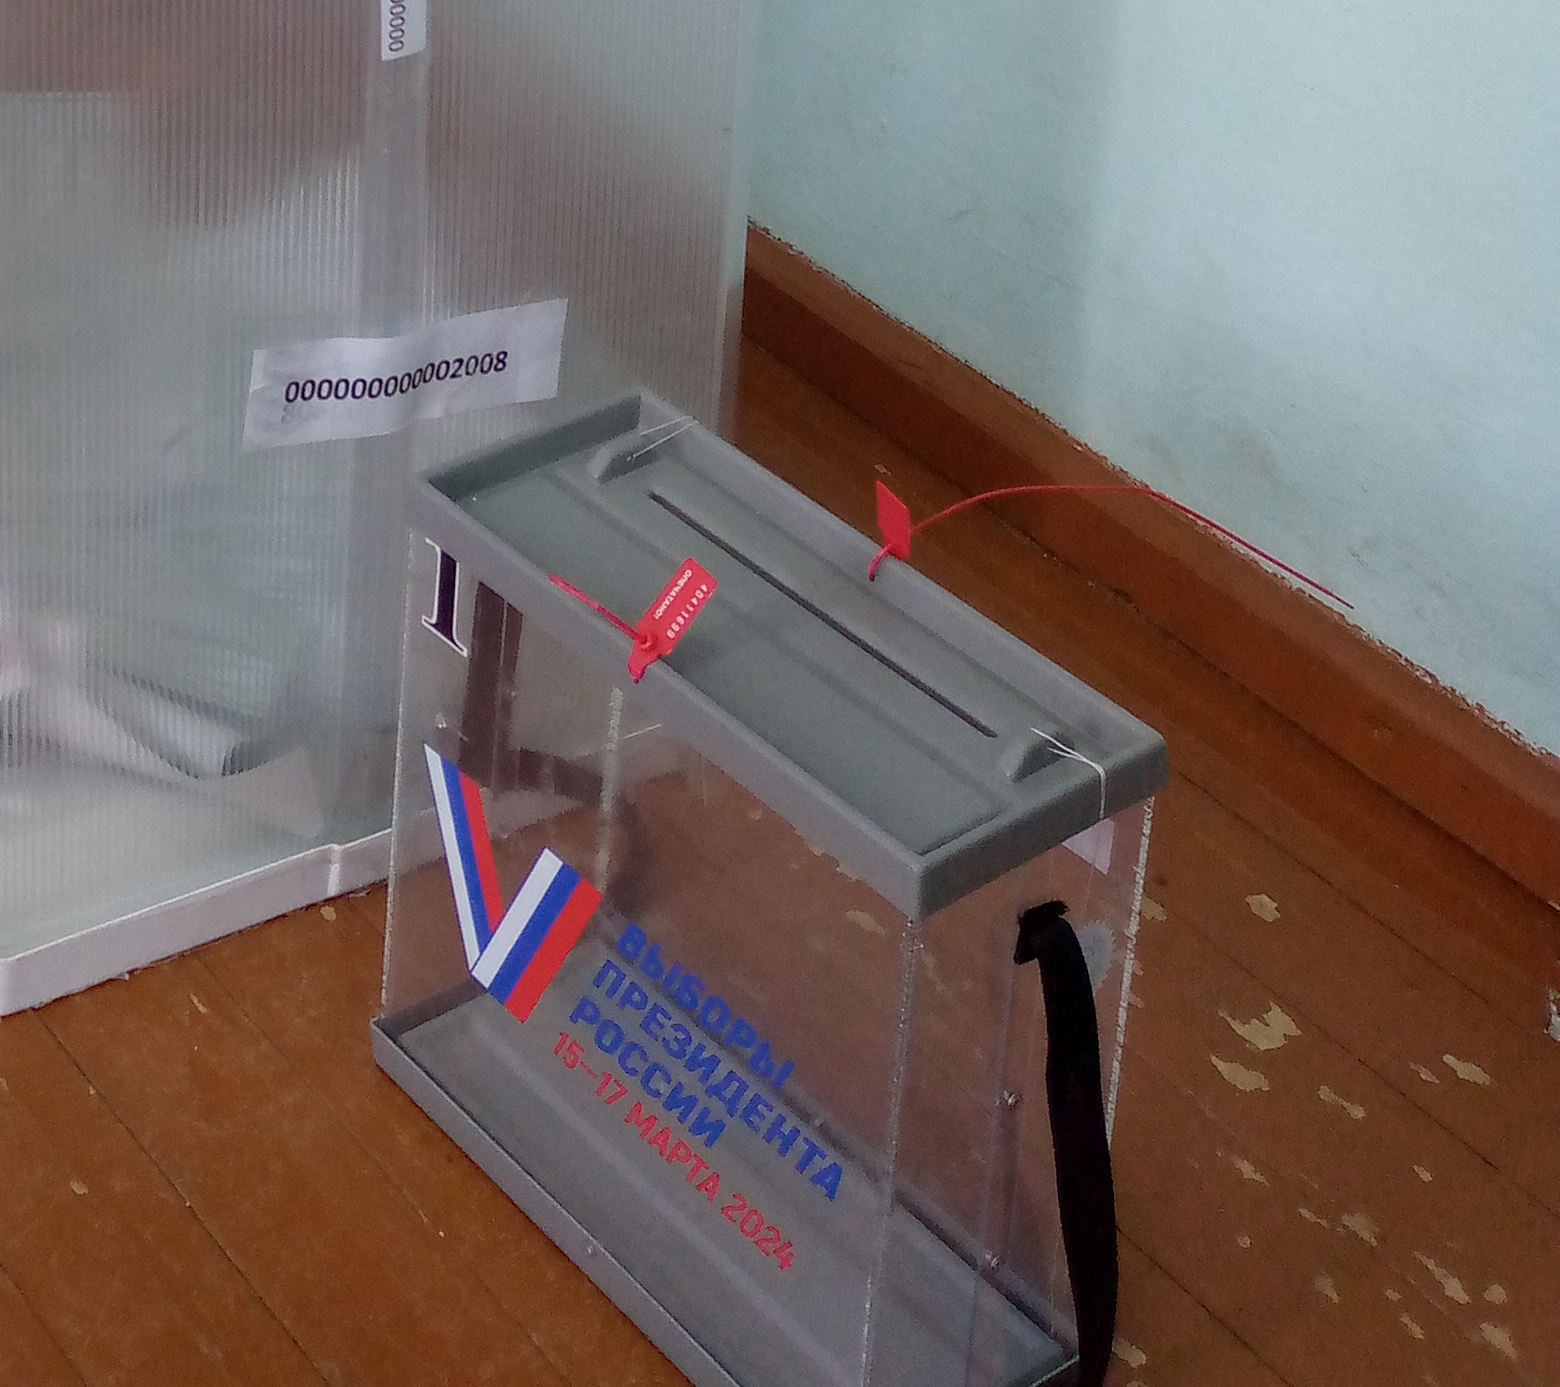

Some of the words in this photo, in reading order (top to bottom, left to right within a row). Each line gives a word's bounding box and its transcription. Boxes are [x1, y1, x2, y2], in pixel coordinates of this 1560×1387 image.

[284, 349, 509, 404] 000000000002008
[652, 568, 694, 621] ОПЕЧАТАНО!
[570, 997, 727, 1148] РОССИИ
[592, 959, 844, 1201] ПРЕЗИДЕНТА
[616, 922, 796, 1090] ВЫБОРЫ
[553, 1031, 628, 1105] 15–17
[624, 1101, 721, 1202] МАРТА
[721, 1192, 794, 1271] 2024
